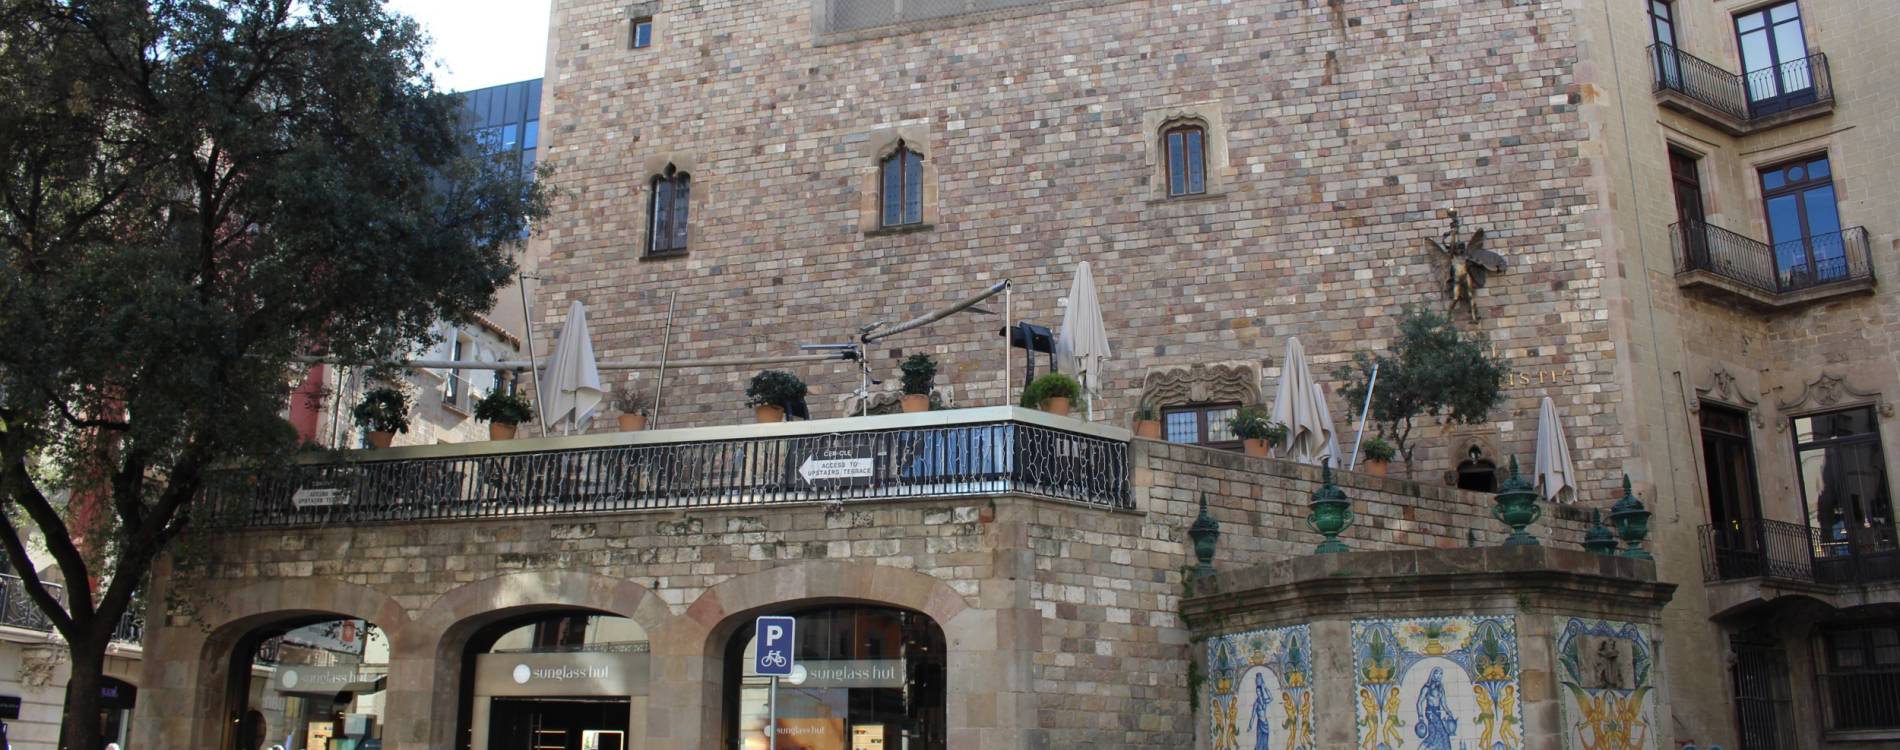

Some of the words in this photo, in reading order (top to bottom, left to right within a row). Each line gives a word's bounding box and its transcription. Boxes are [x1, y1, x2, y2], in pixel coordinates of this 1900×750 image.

[821, 461, 846, 469] ACCESS
[766, 625, 783, 646] P
[533, 665, 586, 680] sunglass
[588, 665, 609, 678] hut
[811, 666, 870, 681] sunglass
[872, 665, 896, 679] hut
